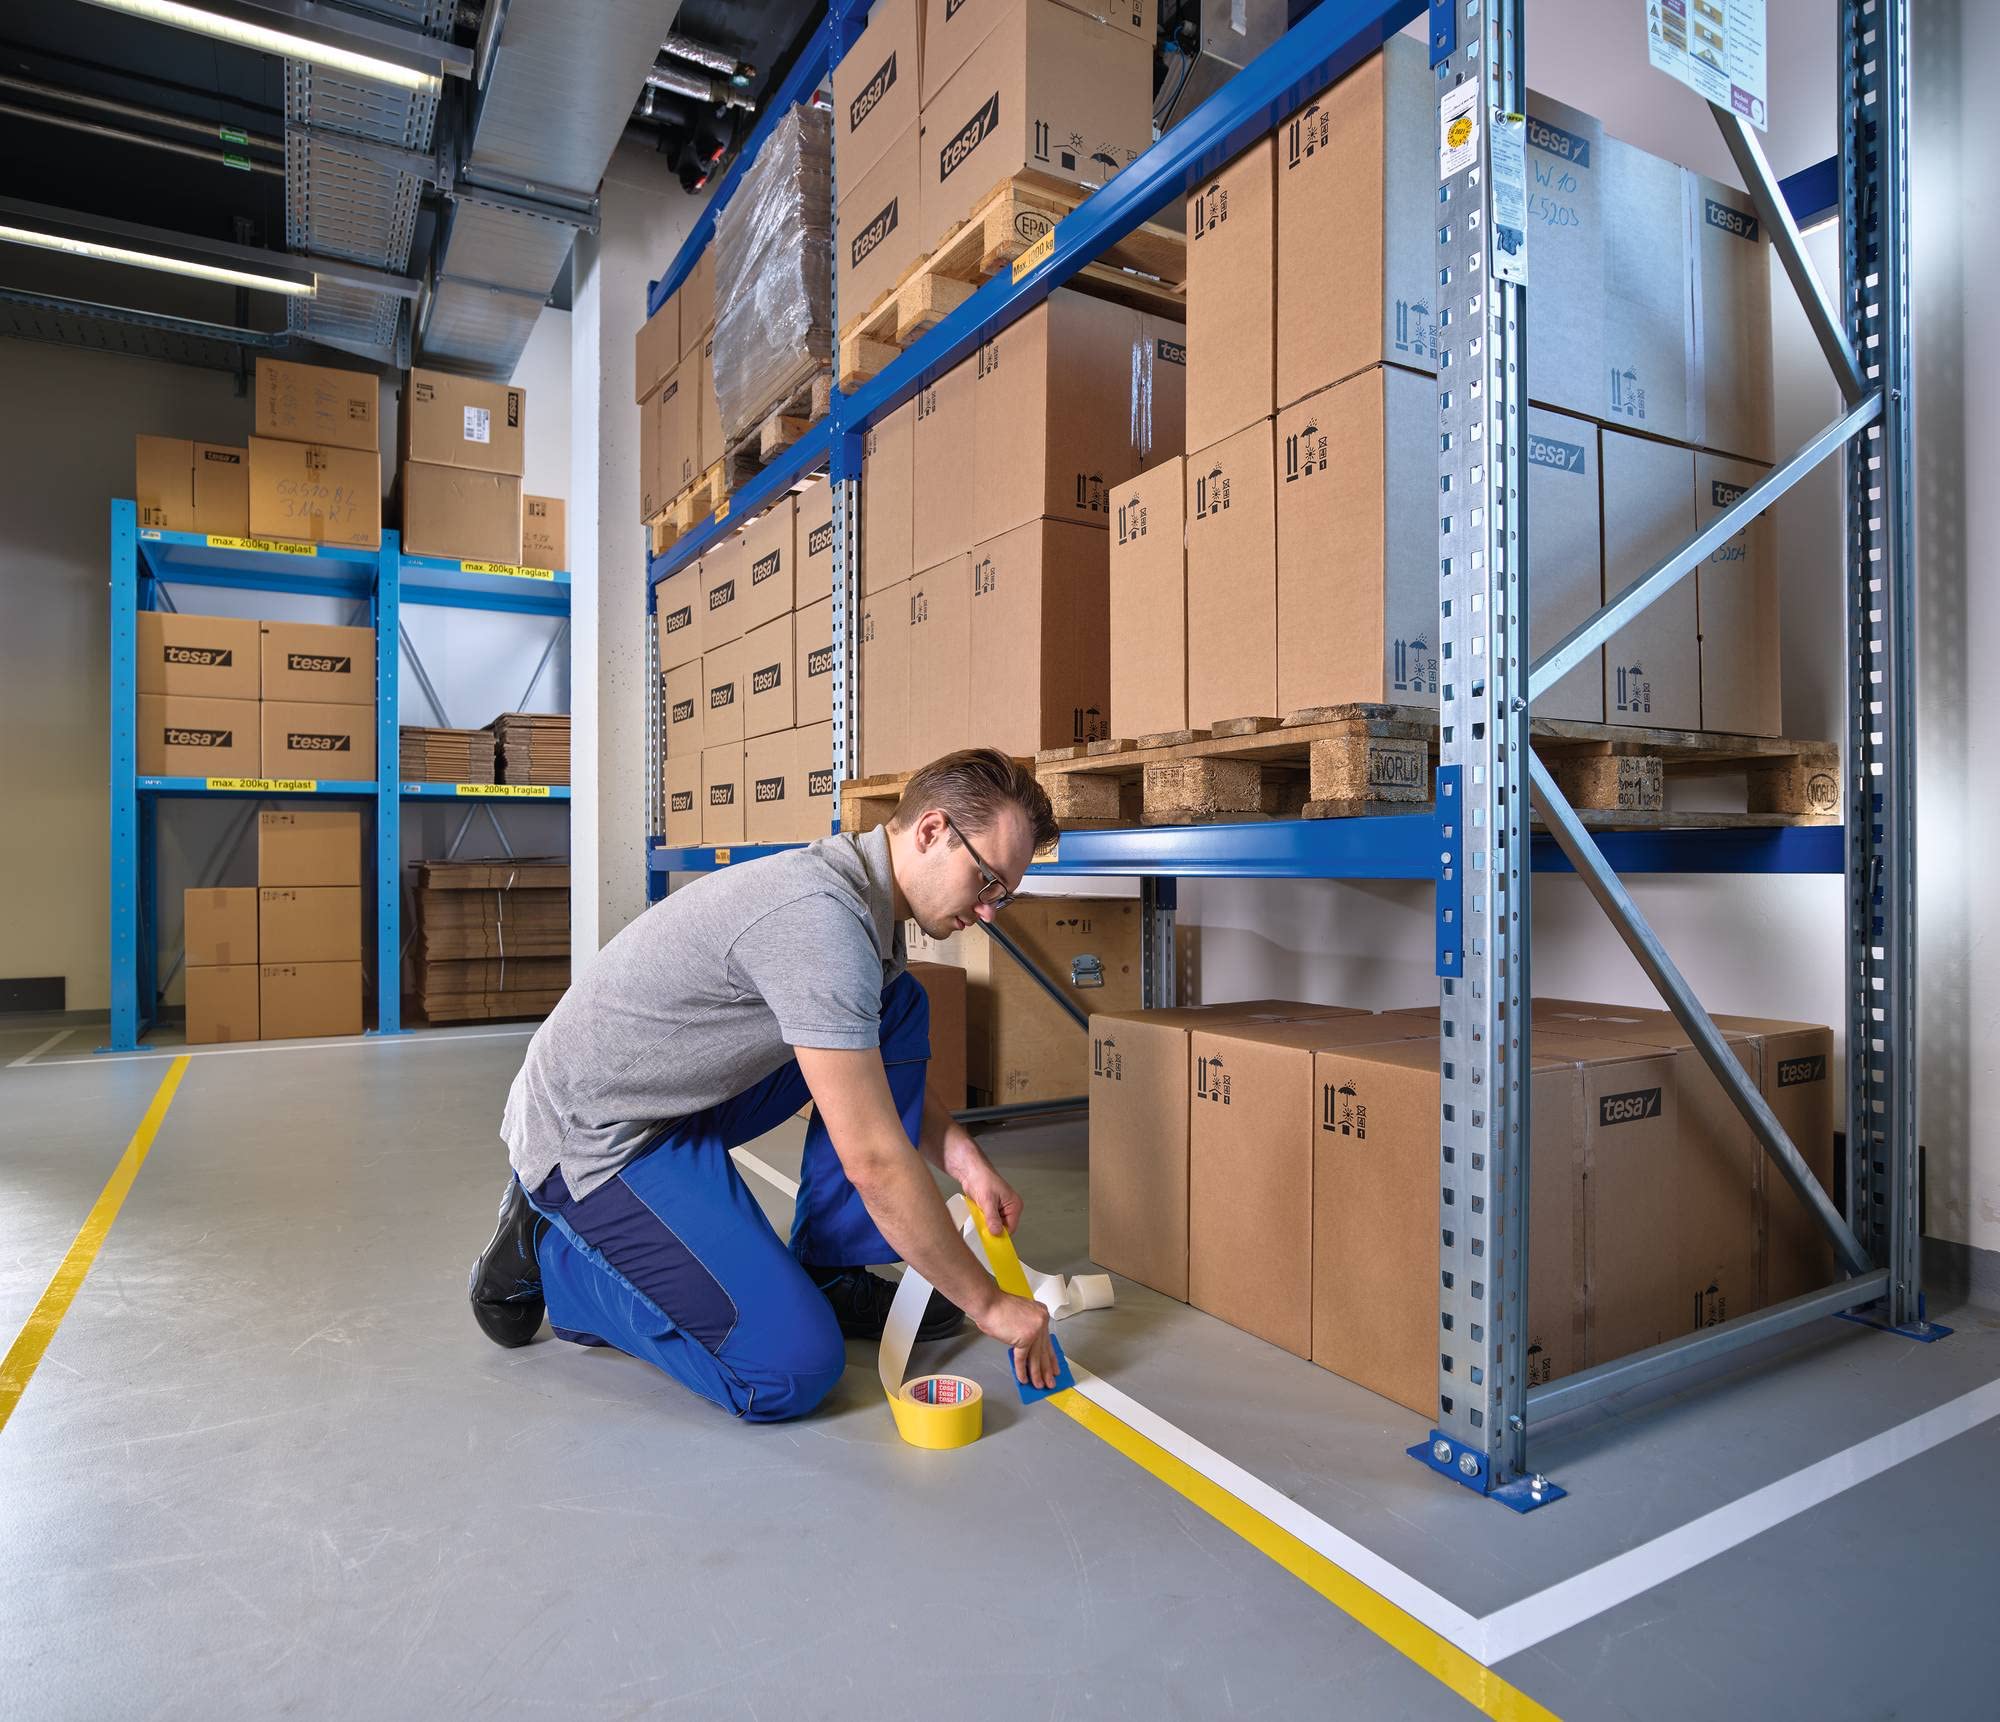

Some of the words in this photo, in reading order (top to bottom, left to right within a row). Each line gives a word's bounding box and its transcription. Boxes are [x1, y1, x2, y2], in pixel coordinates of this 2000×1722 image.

[852, 77, 882, 125] tesa
[942, 121, 980, 174] tesa
[1527, 120, 1570, 156] tesa
[1709, 203, 1744, 233] tesa
[853, 223, 883, 262] tesa
[1161, 343, 1186, 364] tes
[1529, 437, 1566, 466] tesa
[1715, 484, 1742, 505] te
[240, 538, 270, 551] 200kg
[273, 541, 312, 554] Traglast
[810, 527, 833, 552] tesa
[488, 564, 514, 575] 200kg
[516, 566, 550, 578] Traglast
[753, 559, 772, 581] tesa
[710, 588, 727, 607] tesa
[667, 615, 684, 631] tesa
[166, 647, 212, 664] tesa
[290, 655, 333, 671] tesa
[809, 651, 833, 674] tesa
[753, 671, 773, 691] tesa
[711, 690, 728, 706] tesa
[673, 707, 688, 721] tesa
[166, 729, 212, 745] tesa
[290, 735, 332, 750] tesa
[1376, 751, 1419, 780] WORLD
[240, 779, 269, 790] 200kg
[273, 780, 312, 790] Traglast
[484, 785, 510, 795] 200kg
[512, 786, 545, 795] Traglast
[757, 781, 776, 800] tesa
[810, 773, 833, 793] tesa
[1810, 783, 1836, 803] WORLD
[672, 796, 687, 810] tesa
[711, 788, 728, 804] tesa
[1780, 1060, 1812, 1083] tesa
[1603, 1095, 1644, 1122] tesa
